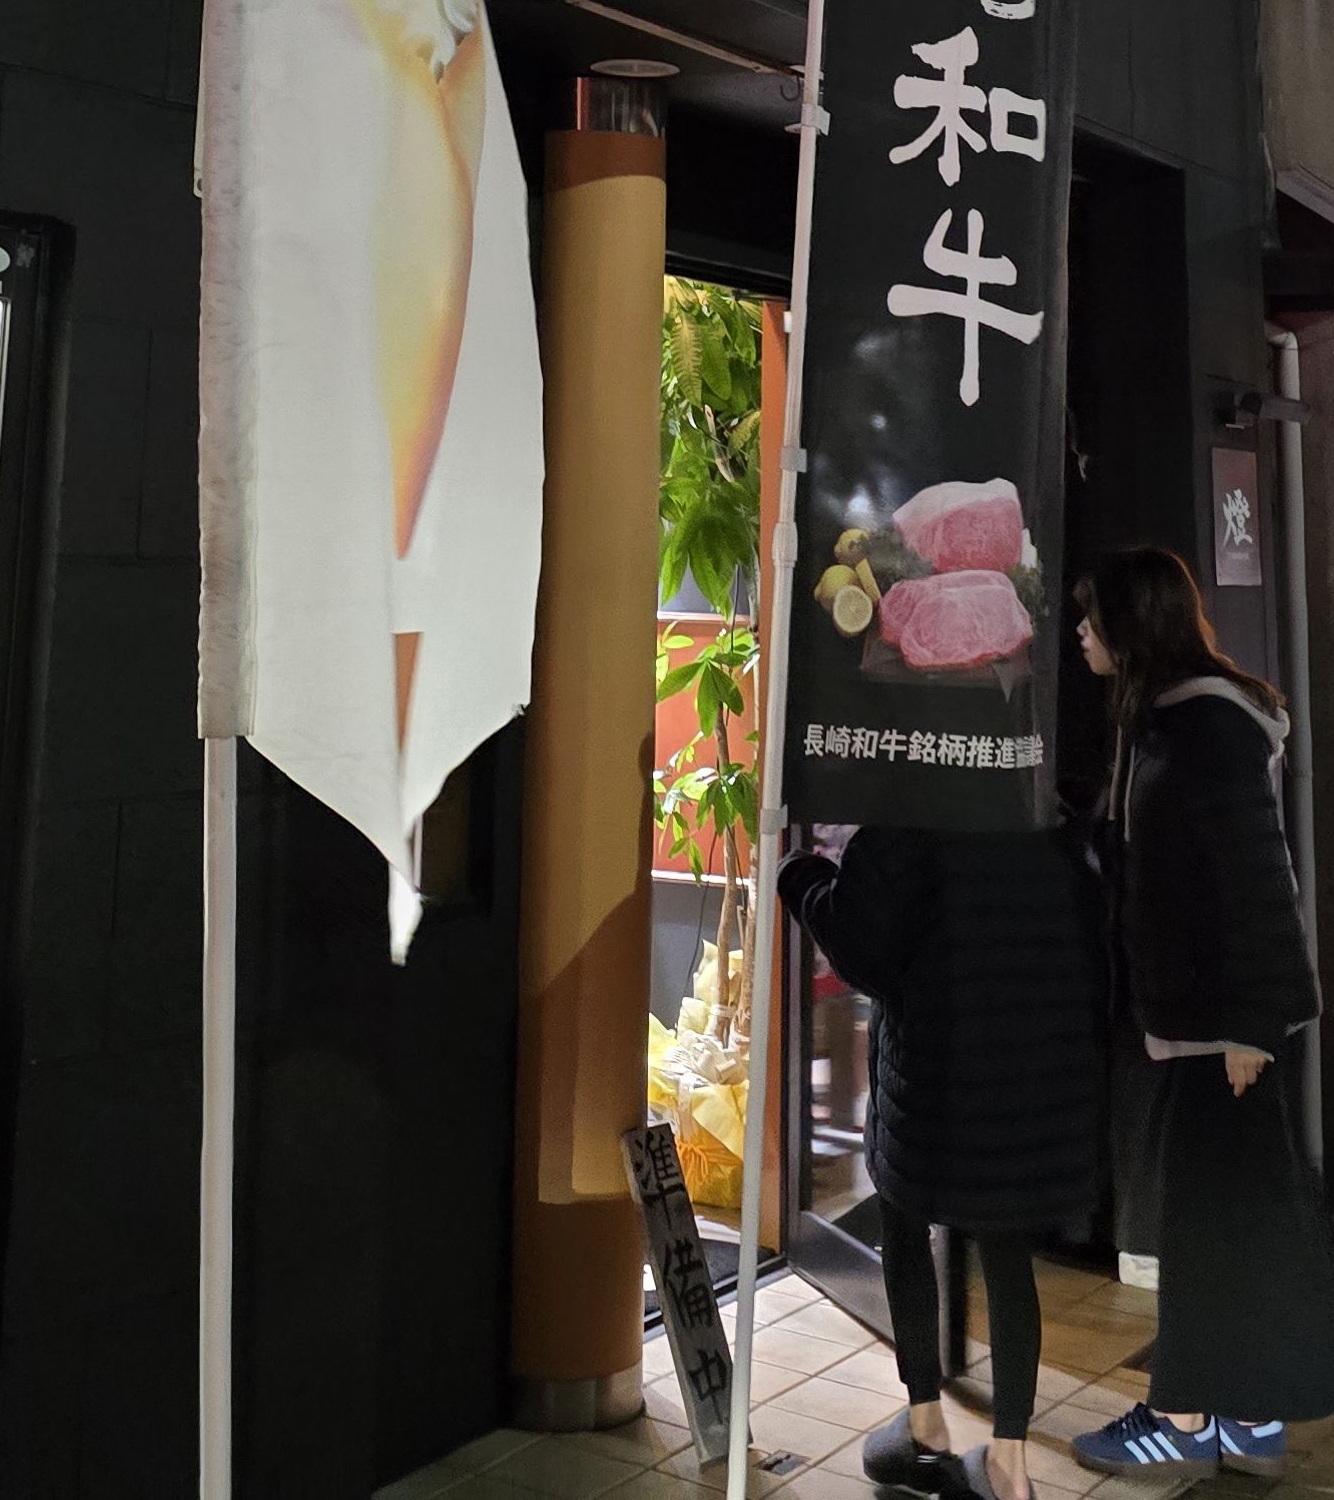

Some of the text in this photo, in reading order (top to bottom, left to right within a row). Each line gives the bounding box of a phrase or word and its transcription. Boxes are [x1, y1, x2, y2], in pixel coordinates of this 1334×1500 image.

[803, 722, 1045, 770] 長崎和牛銘柄推進議会
[634, 1130, 729, 1426] 準備中
